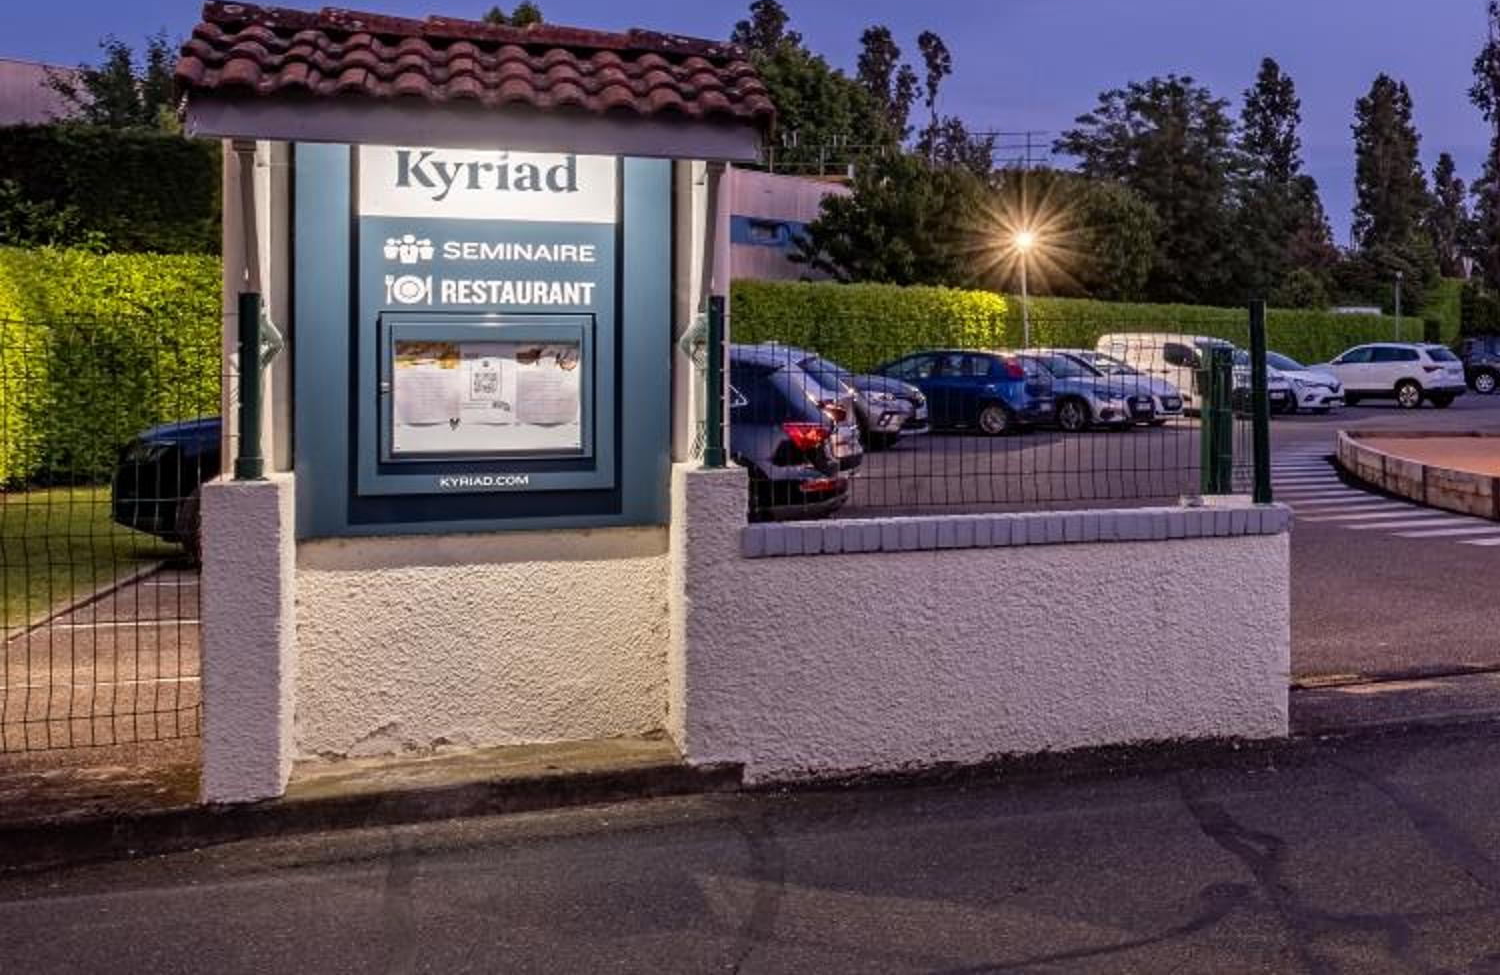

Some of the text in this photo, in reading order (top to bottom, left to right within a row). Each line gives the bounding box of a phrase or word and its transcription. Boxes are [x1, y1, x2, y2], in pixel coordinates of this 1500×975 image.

[396, 149, 579, 201] Kyriad
[443, 242, 596, 262] SEMINAIRE
[441, 280, 595, 305] RESTAURANT
[439, 474, 529, 488] KYRIAD.COM
